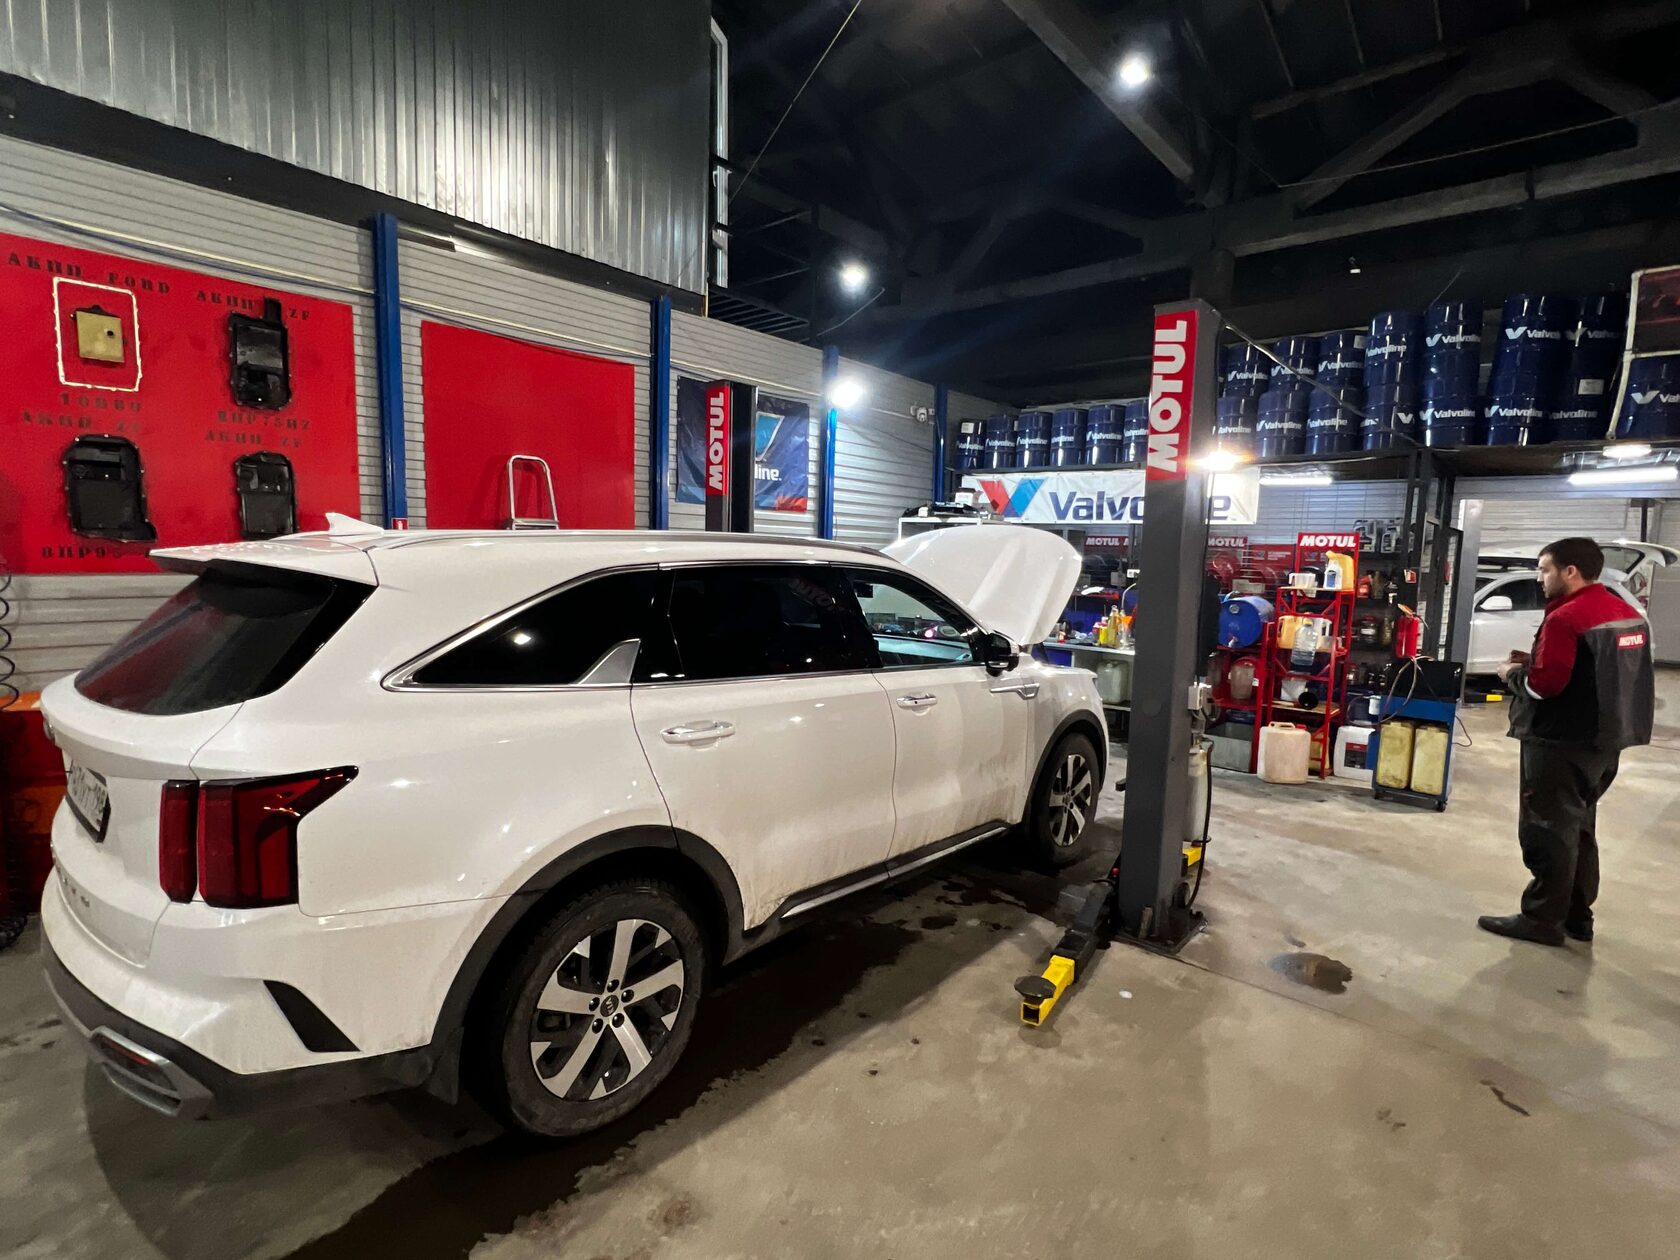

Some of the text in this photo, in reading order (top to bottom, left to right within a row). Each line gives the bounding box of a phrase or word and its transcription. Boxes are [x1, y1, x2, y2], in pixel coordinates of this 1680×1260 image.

[1147, 319, 1188, 473] MOTUL
[709, 391, 725, 491] MOTUL
[1086, 537, 1120, 546] MOTUL
[1297, 535, 1357, 548] MOTUL
[1619, 634, 1644, 647] MOTUL
